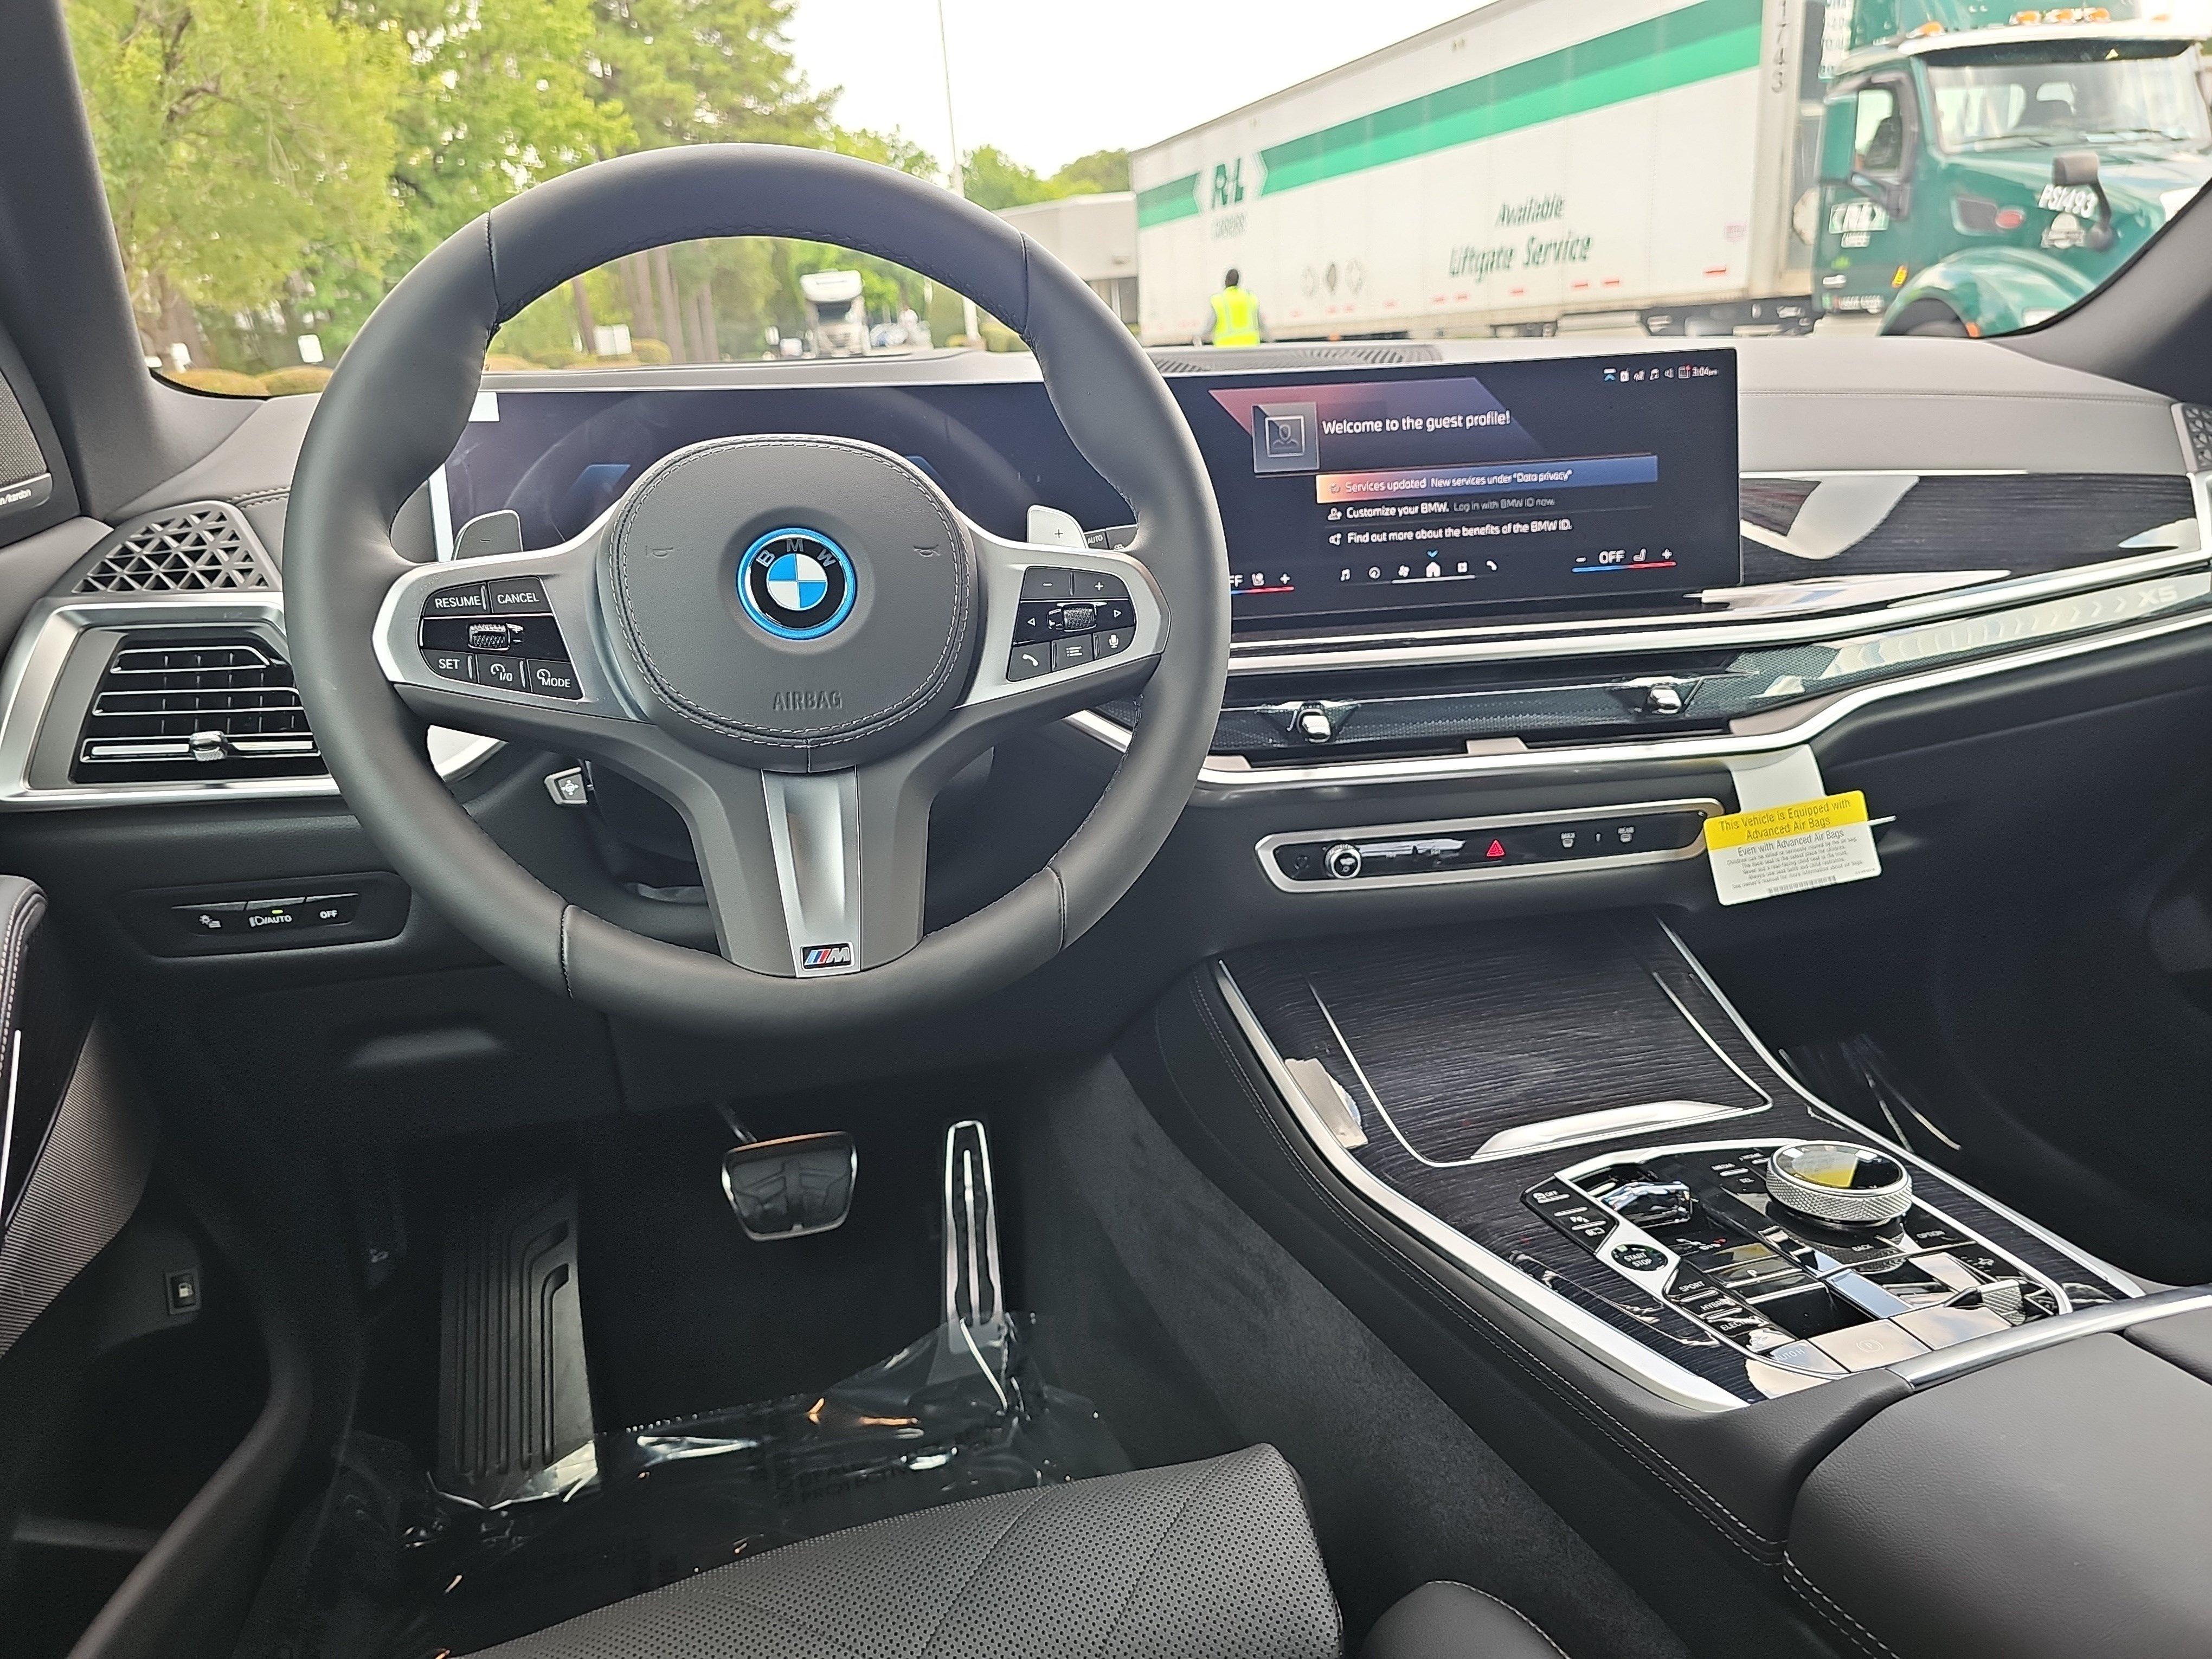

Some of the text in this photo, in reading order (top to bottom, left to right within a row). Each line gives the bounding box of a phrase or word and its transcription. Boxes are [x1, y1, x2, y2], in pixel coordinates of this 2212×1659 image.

[1495, 193, 1565, 228] Available
[1522, 230, 1591, 266] Service
[1322, 410, 1510, 435] Welcome to the guest profile!
[1345, 480, 1386, 493] Services
[1387, 477, 1427, 492] updated
[1431, 478, 1451, 487] New
[1451, 475, 1486, 487] services
[1487, 473, 1513, 485] under
[1346, 505, 1397, 518] Customize
[1397, 505, 1419, 517] your
[1420, 501, 1450, 513] BMW.
[1454, 502, 1470, 513] Log
[1471, 501, 1480, 510] in
[1481, 500, 1499, 510] with
[1500, 498, 1523, 509] BMW
[1525, 497, 1535, 507] ID
[1347, 519, 1573, 543] Find out more about the benefits of the BMW ID.
[1088, 534, 1103, 544] AUTO
[756, 539, 836, 567] BMW
[1599, 550, 1625, 564] OFF
[1230, 574, 1243, 588] FF
[434, 595, 482, 609] RESUME
[497, 592, 540, 605] CANCEL
[2138, 584, 2177, 609] X5
[438, 658, 460, 670] SET
[542, 677, 571, 688] MODE
[773, 691, 843, 712] AIRBAG
[1719, 798, 1851, 832] This Vehicle is Equipped with
[1746, 816, 1831, 841] Advanced Air Bags
[1738, 828, 1844, 857] Even with Advanced Air Bags
[319, 910, 338, 919] OFF
[1916, 1230, 1946, 1239] OPTION
[1851, 1244, 1874, 1252] BACK
[1623, 1252, 1648, 1262] START
[1631, 1258, 1653, 1268] STOP
[1679, 1280, 1706, 1293] SPORT
[1774, 1349, 1798, 1362] AUTO
